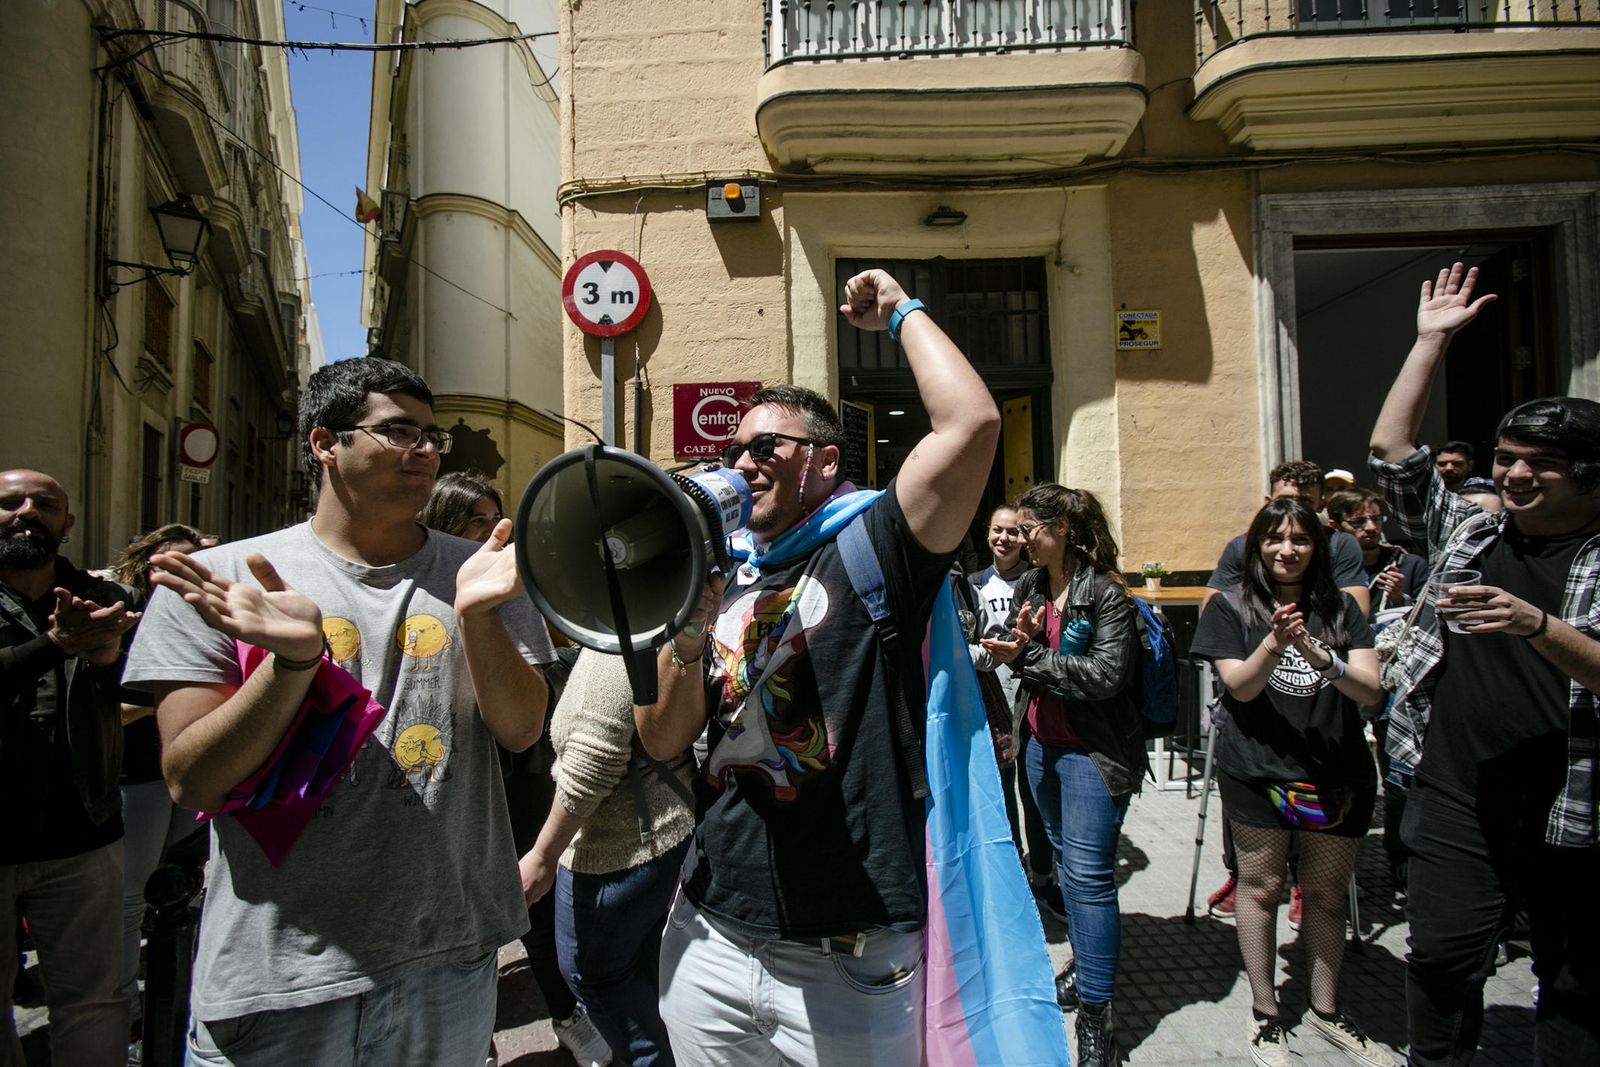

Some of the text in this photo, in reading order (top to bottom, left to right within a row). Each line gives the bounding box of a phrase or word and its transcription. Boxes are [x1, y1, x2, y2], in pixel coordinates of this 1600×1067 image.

[582, 282, 634, 305] 3 m
[700, 387, 736, 397] NUEVO
[683, 443, 716, 454] CAFÉ
[404, 675, 441, 690] SUMMER
[403, 789, 440, 807] WINTER
